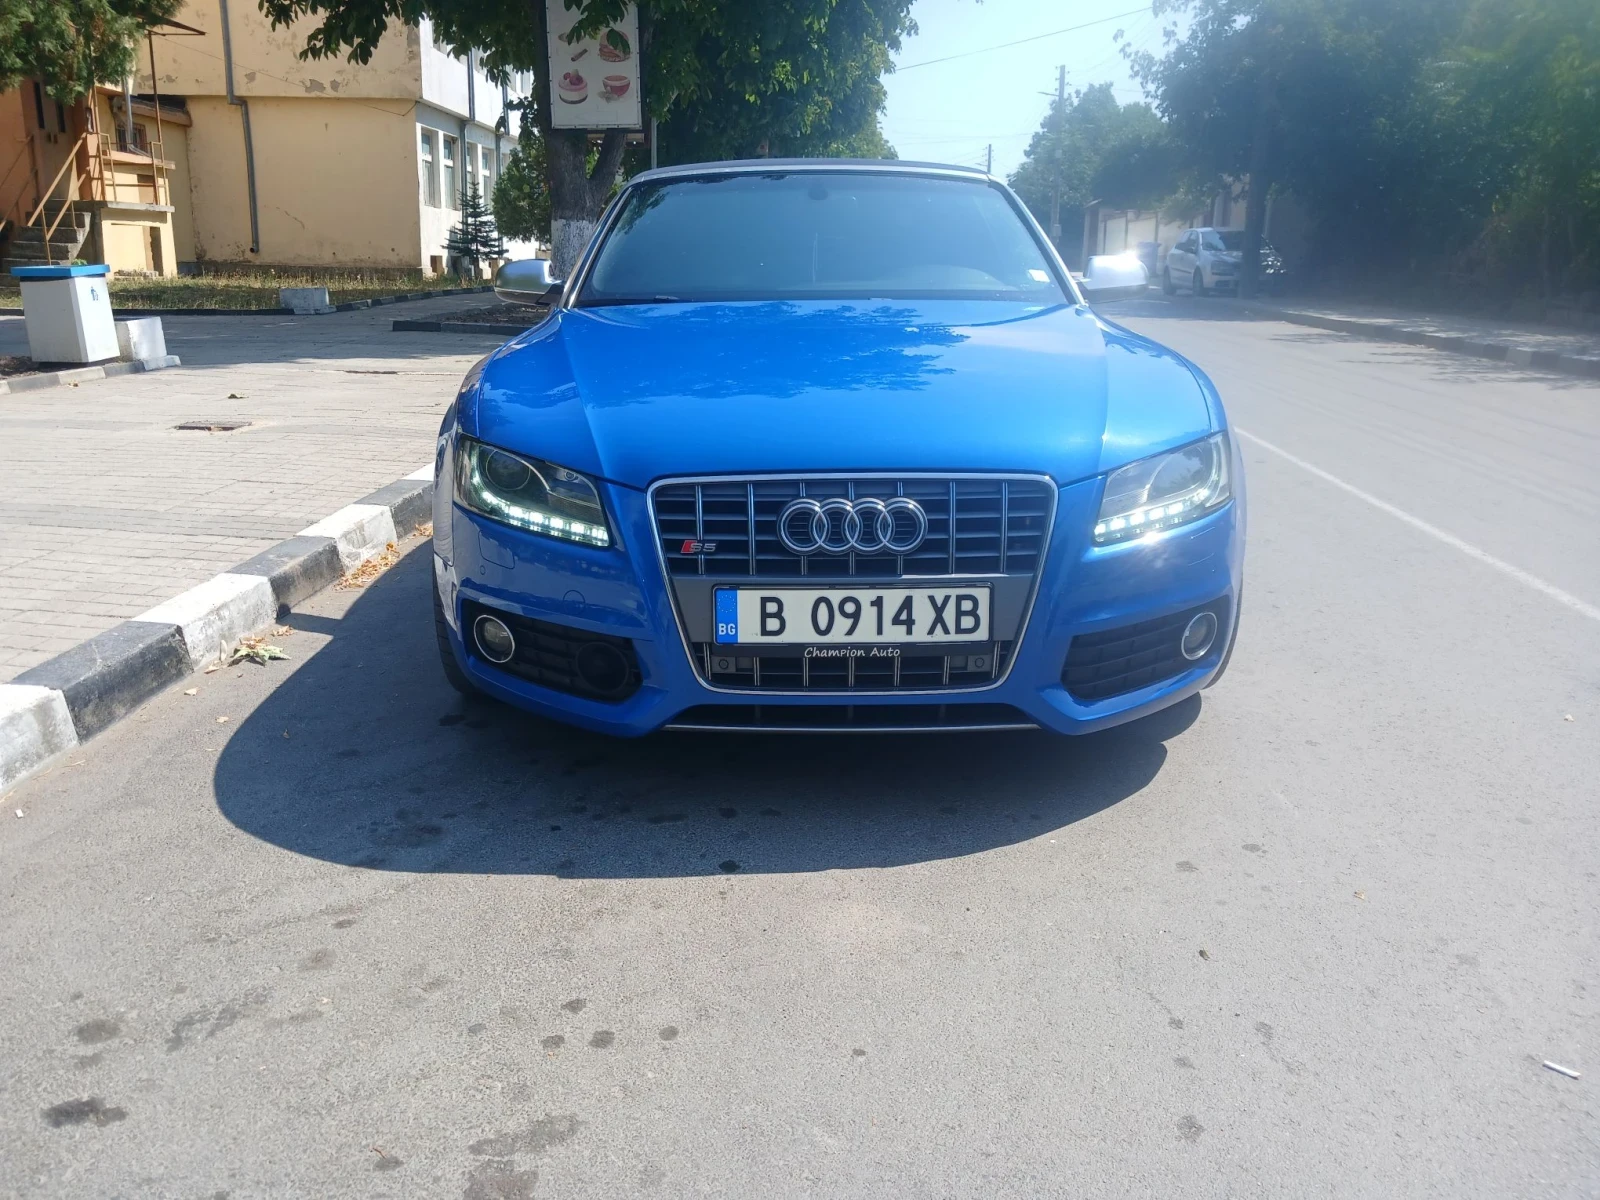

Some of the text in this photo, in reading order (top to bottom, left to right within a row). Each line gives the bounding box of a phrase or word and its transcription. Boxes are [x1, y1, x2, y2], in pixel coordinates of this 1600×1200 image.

[690, 543, 717, 552] S5
[718, 623, 736, 635] BG
[804, 646, 901, 658] Champion Auto
